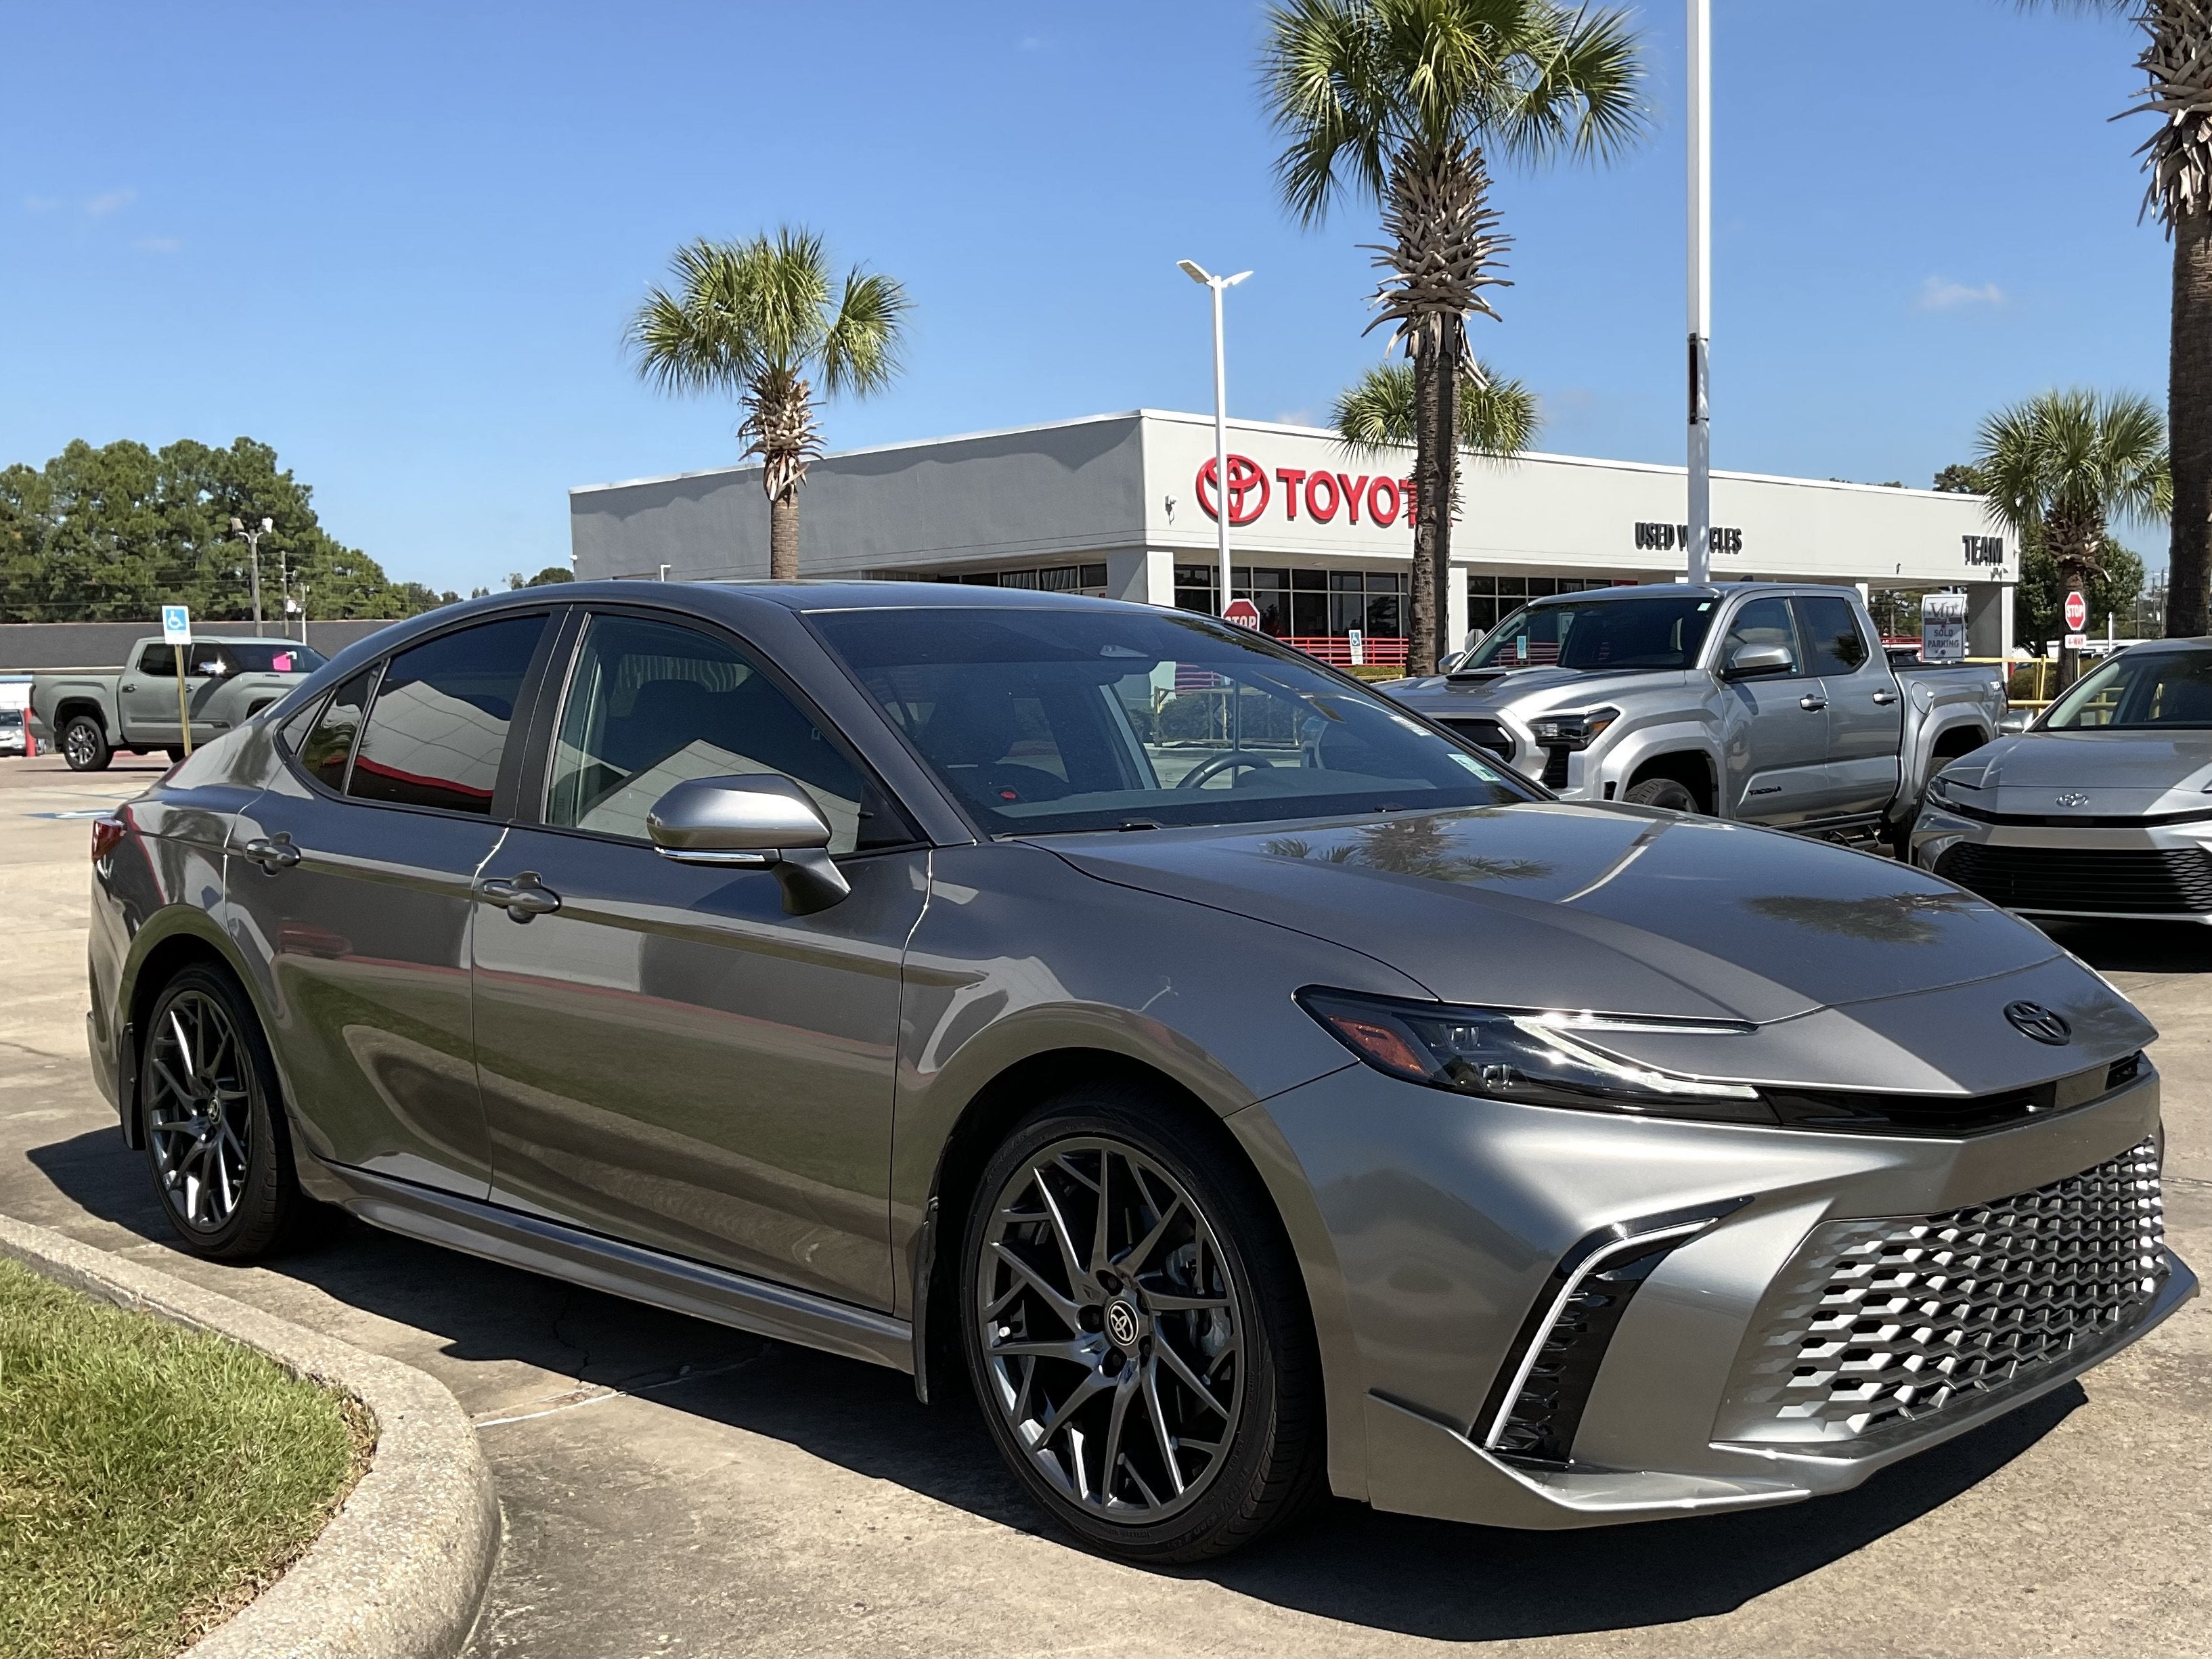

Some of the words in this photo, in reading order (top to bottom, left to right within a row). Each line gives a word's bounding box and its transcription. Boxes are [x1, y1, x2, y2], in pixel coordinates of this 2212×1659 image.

[1276, 468, 1453, 529] TOYOT
[1635, 522, 1675, 550] USED
[1677, 525, 1742, 554] VCLES
[1962, 535, 2003, 566] TEAM
[2066, 604, 2083, 617] STOP
[1927, 640, 1960, 648] PARKING
[1934, 629, 1953, 637] SOLD
